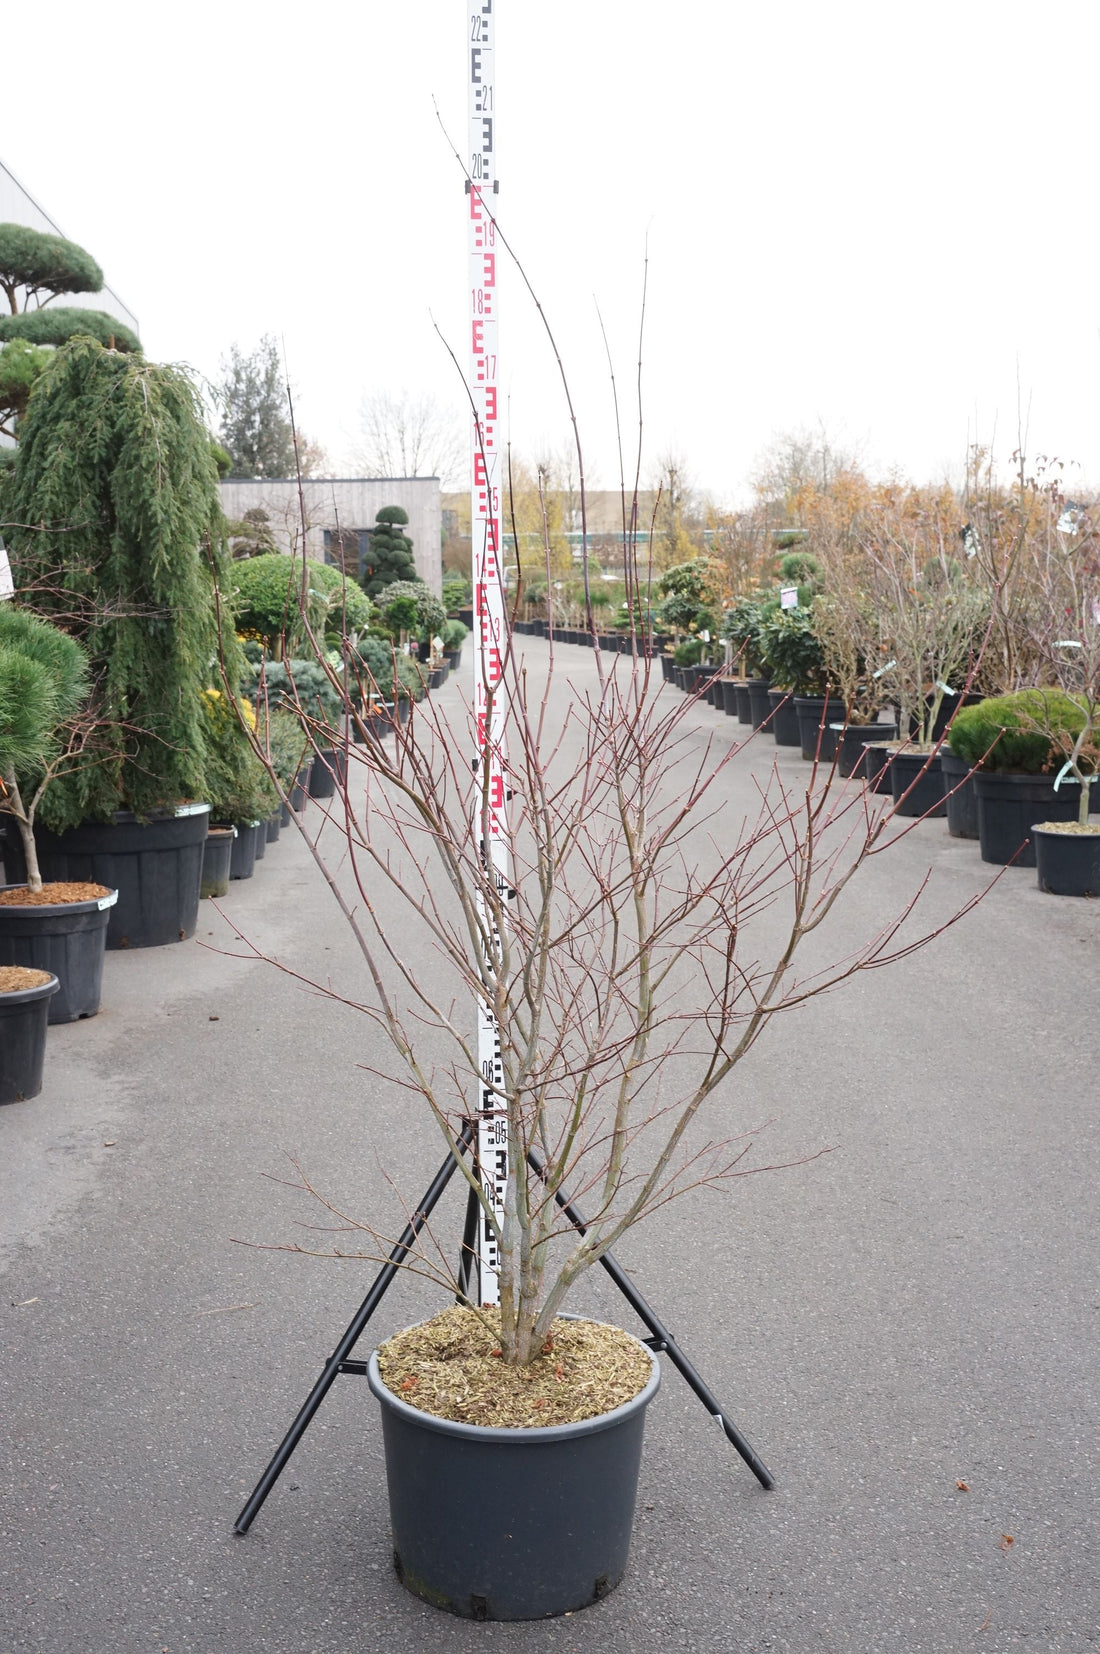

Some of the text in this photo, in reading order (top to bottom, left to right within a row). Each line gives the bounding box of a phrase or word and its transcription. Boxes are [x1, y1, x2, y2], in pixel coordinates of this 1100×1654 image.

[471, 15, 482, 42] 22
[482, 85, 493, 111] 21
[472, 153, 482, 179] 20
[483, 220, 495, 247] 19
[472, 288, 483, 314] 18
[485, 355, 496, 380] 17
[483, 1060, 494, 1083] 06
[496, 1121, 506, 1144] 05
